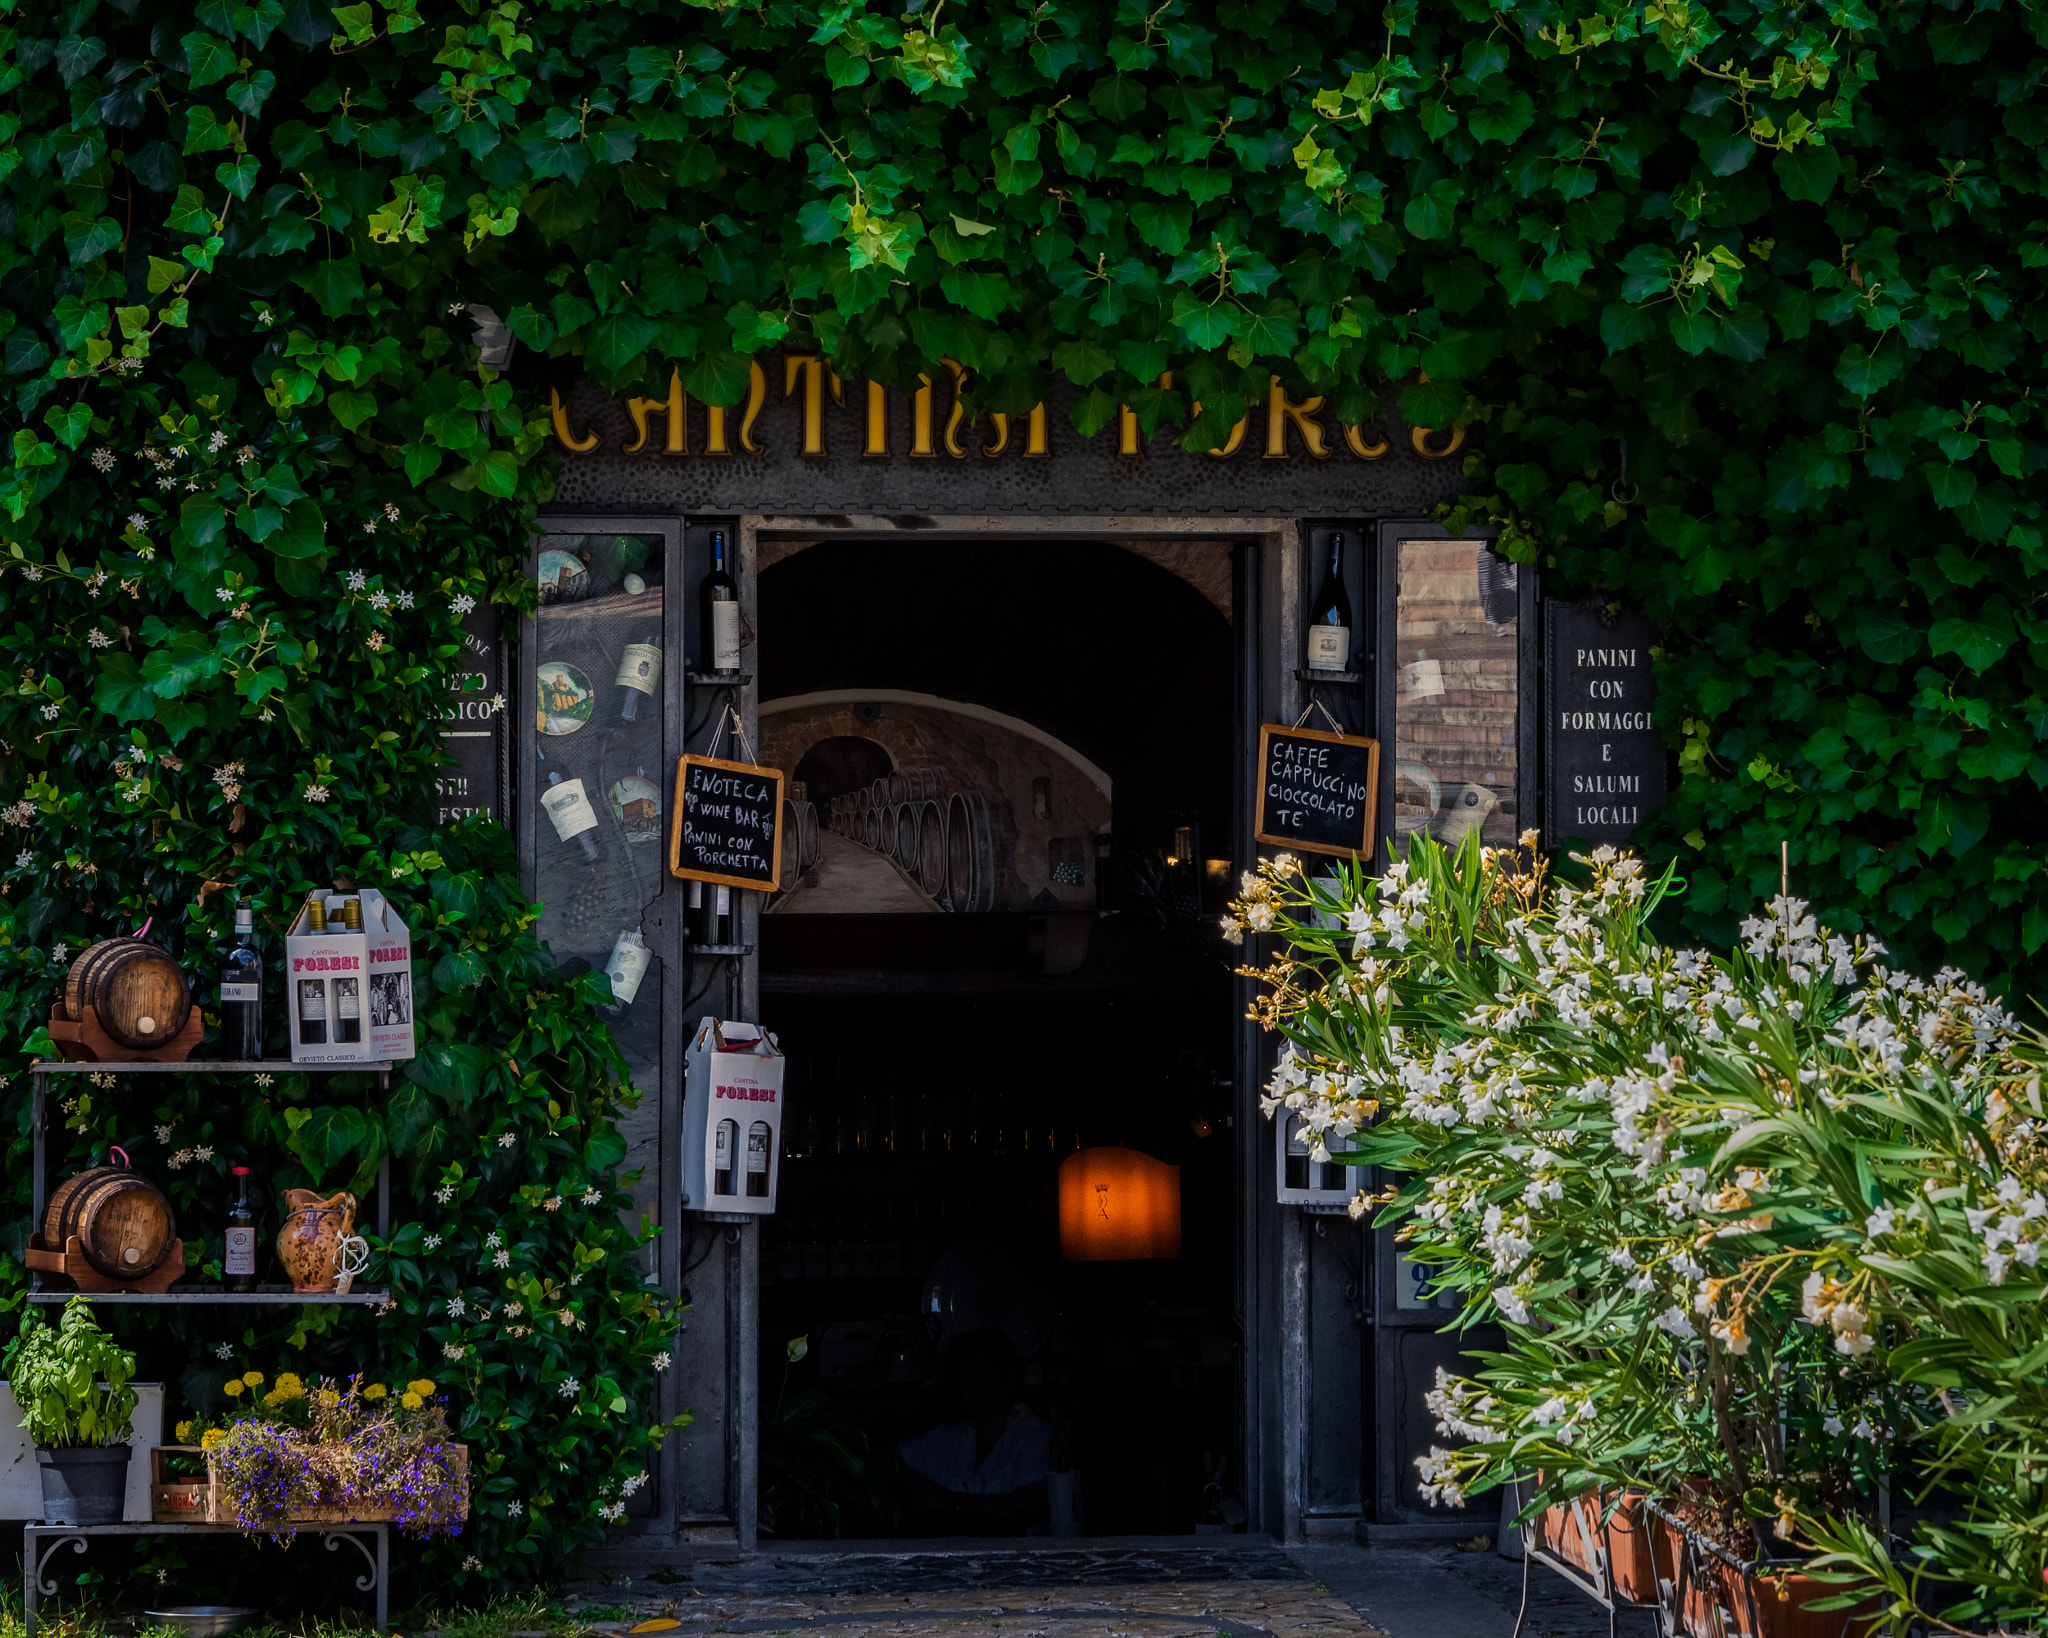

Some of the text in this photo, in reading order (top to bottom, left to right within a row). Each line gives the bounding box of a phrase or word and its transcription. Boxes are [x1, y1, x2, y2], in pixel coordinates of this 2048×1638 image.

[1576, 649, 1637, 667] PANINI
[1589, 680, 1624, 699] CON
[1561, 711, 1653, 730] FORMAGGI
[1273, 742, 1331, 768] CAFFE
[1601, 743, 1612, 762] E
[692, 769, 769, 802] ENOTECA
[1574, 775, 1640, 793] SALUMI
[1268, 783, 1355, 818] CIOCCOLATO
[700, 803, 760, 828] WINE BAR
[1577, 806, 1638, 825] LOCALI
[684, 821, 754, 851] PANINI CON
[694, 845, 769, 872] PORCHETTA
[292, 956, 360, 972] FORESI
[369, 946, 408, 964] FORESI
[298, 1055, 325, 1063] ORVIETO
[326, 1054, 356, 1062] CLASSICO
[715, 1085, 776, 1102] FORESI
[1411, 1262, 1430, 1301] 2
